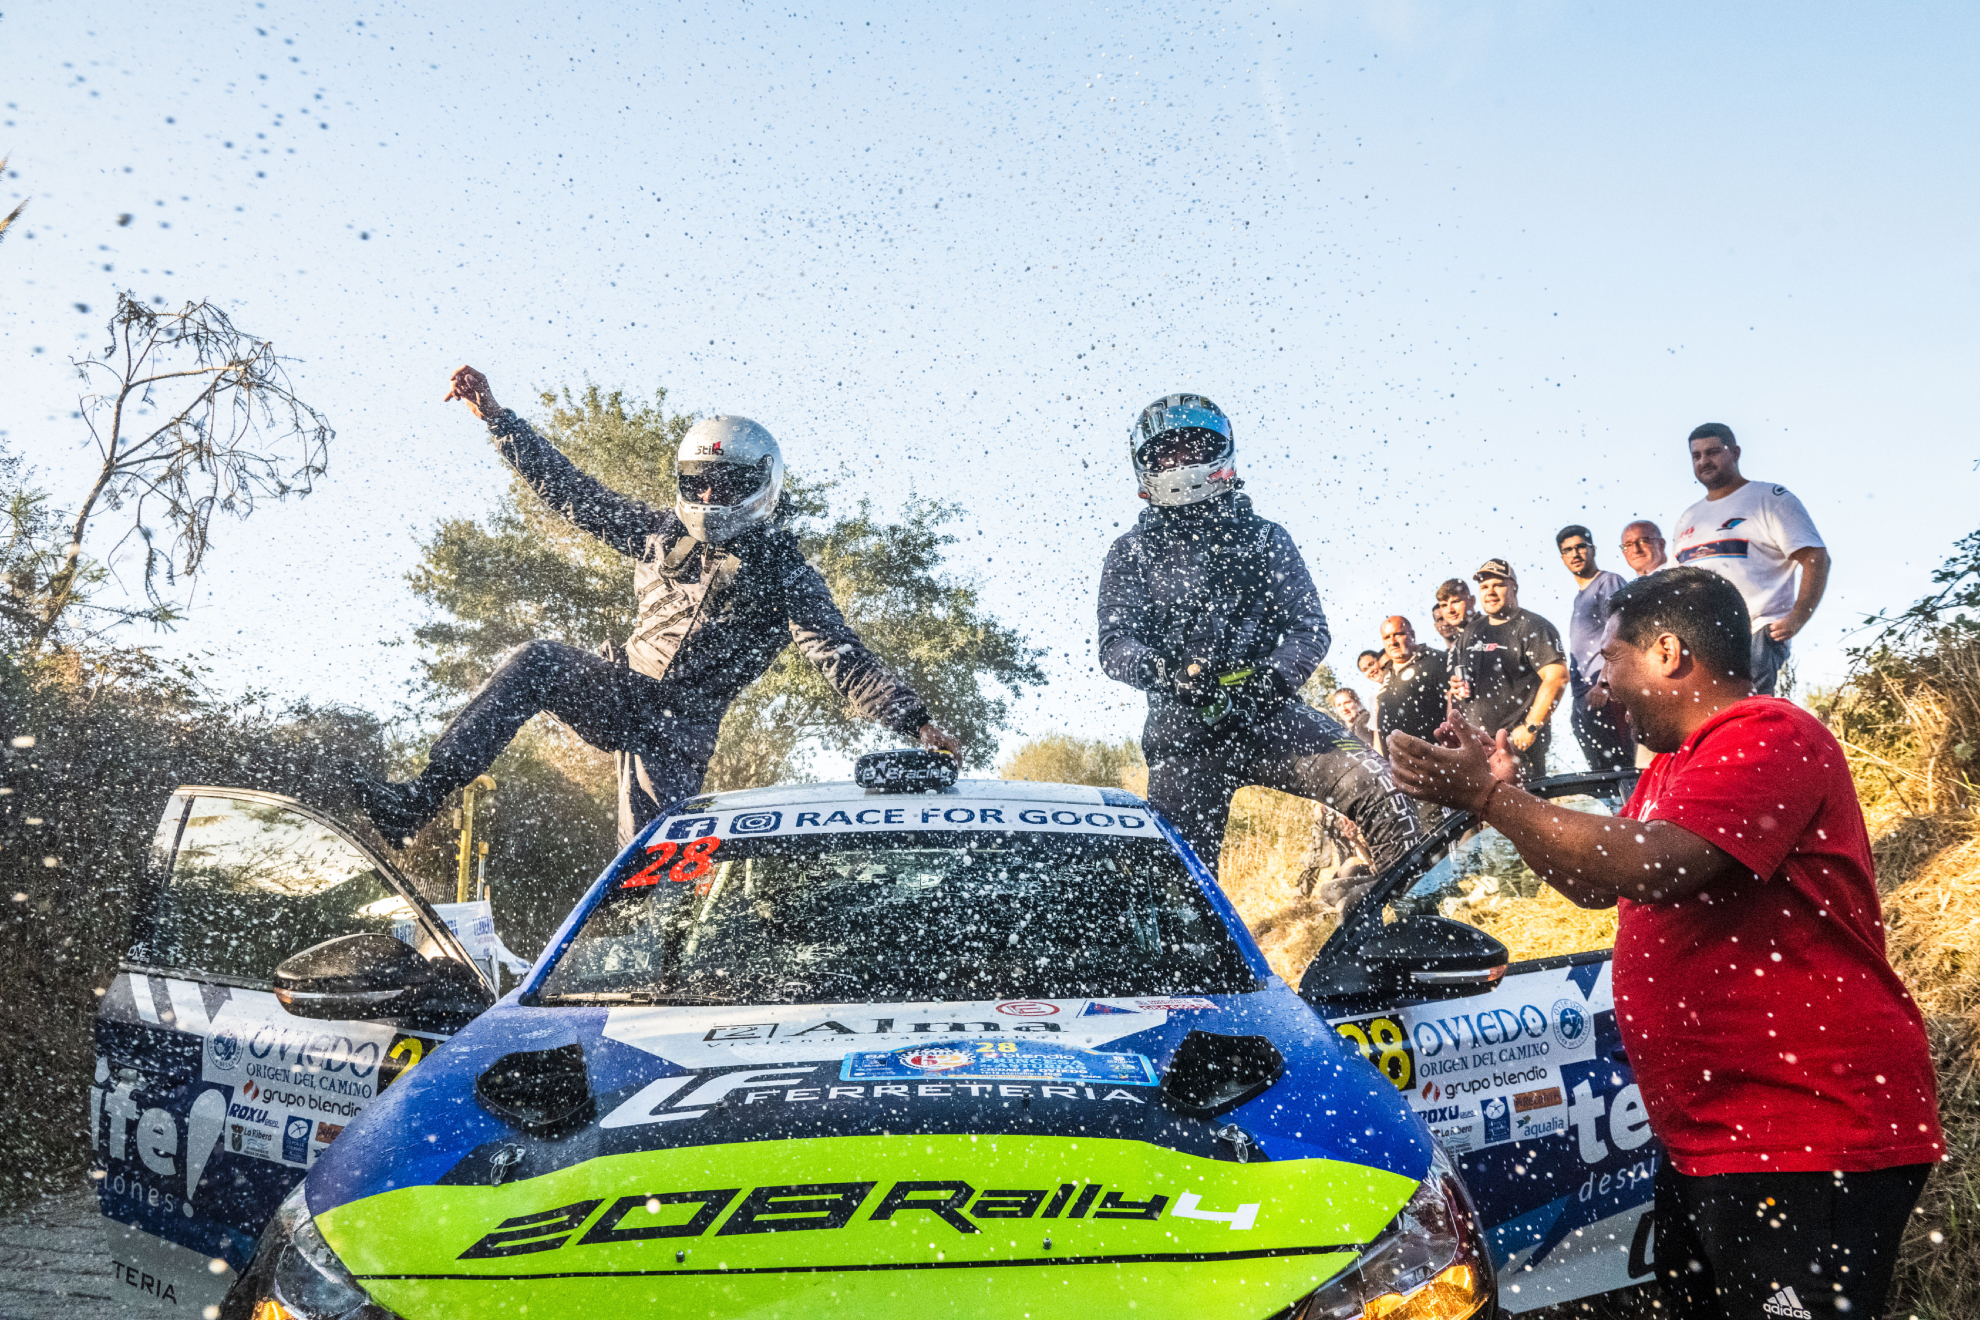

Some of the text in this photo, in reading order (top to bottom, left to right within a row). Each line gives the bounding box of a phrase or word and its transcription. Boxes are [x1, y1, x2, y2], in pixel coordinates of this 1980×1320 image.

[795, 808, 1146, 831] RACE FOR GOOD
[621, 836, 721, 889] 28
[785, 1018, 1069, 1038] Alma
[1413, 1005, 1547, 1057] OVIEDO
[250, 1025, 380, 1078] OVIEDO
[976, 1042, 1018, 1053] 28
[1420, 1041, 1550, 1078] ORIGEN DEL CAMINO
[247, 1062, 372, 1099] ORIGEN DEL CAMINO
[744, 1083, 1146, 1105] FERRETERIA
[1445, 1066, 1548, 1099] grupo blendio
[262, 1088, 305, 1108] grupo
[228, 1103, 269, 1123] ROXU
[1524, 1116, 1564, 1138] aqualia
[867, 1179, 1172, 1233] Rally
[1171, 1192, 1260, 1231] 4
[112, 1259, 178, 1305] TERIA
[1762, 1302, 1813, 1320] adidas
